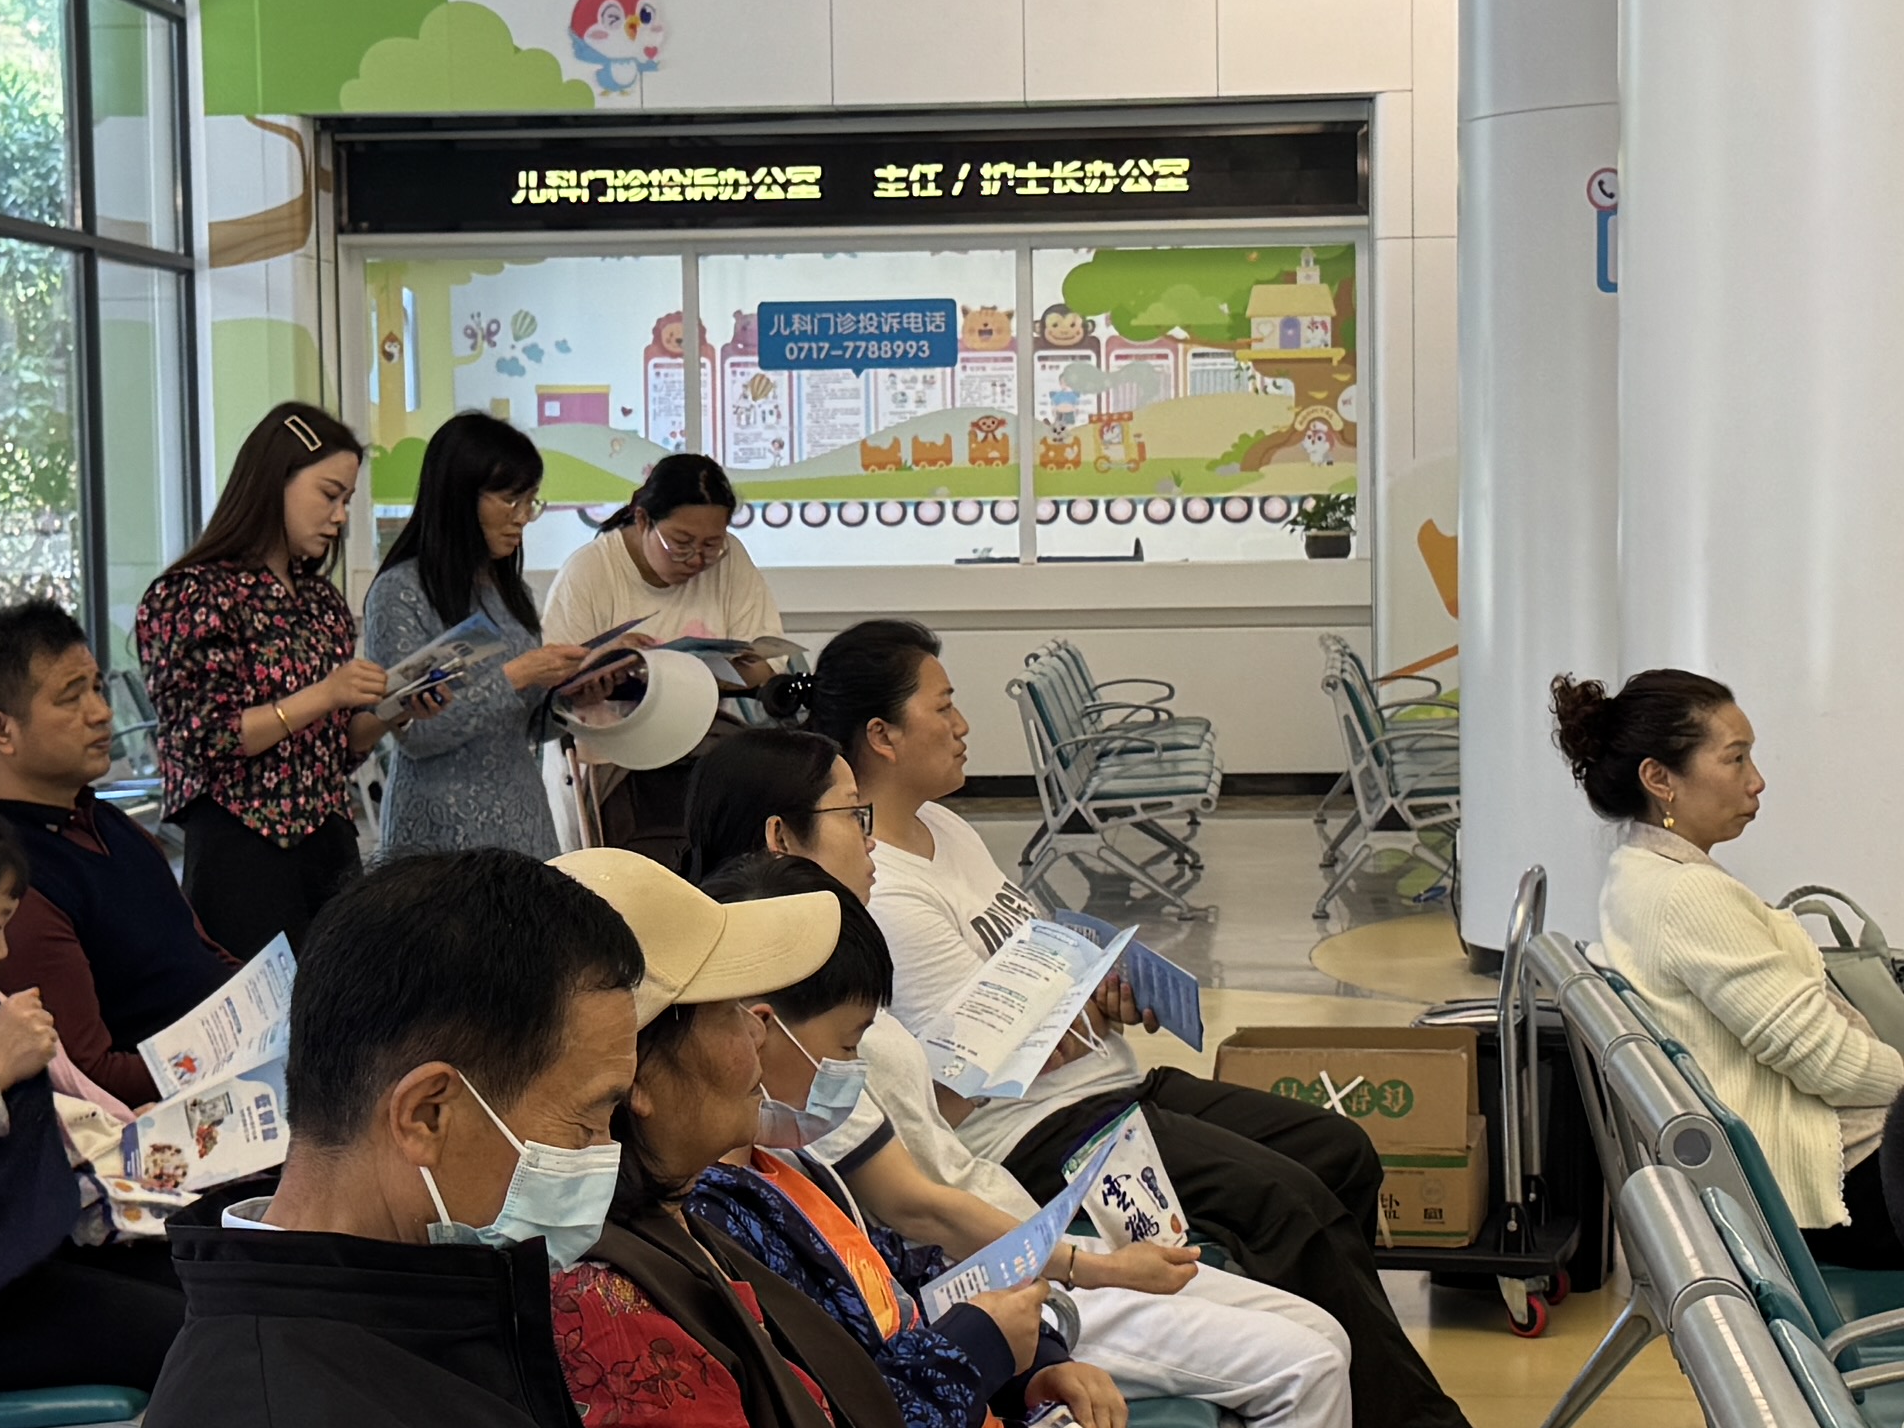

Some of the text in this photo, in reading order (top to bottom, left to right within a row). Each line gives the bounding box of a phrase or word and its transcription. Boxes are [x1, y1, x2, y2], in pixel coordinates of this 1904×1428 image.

[511, 165, 822, 205] 儿科门诊投诉办公室
[769, 311, 947, 338] 儿科门诊投诉电话
